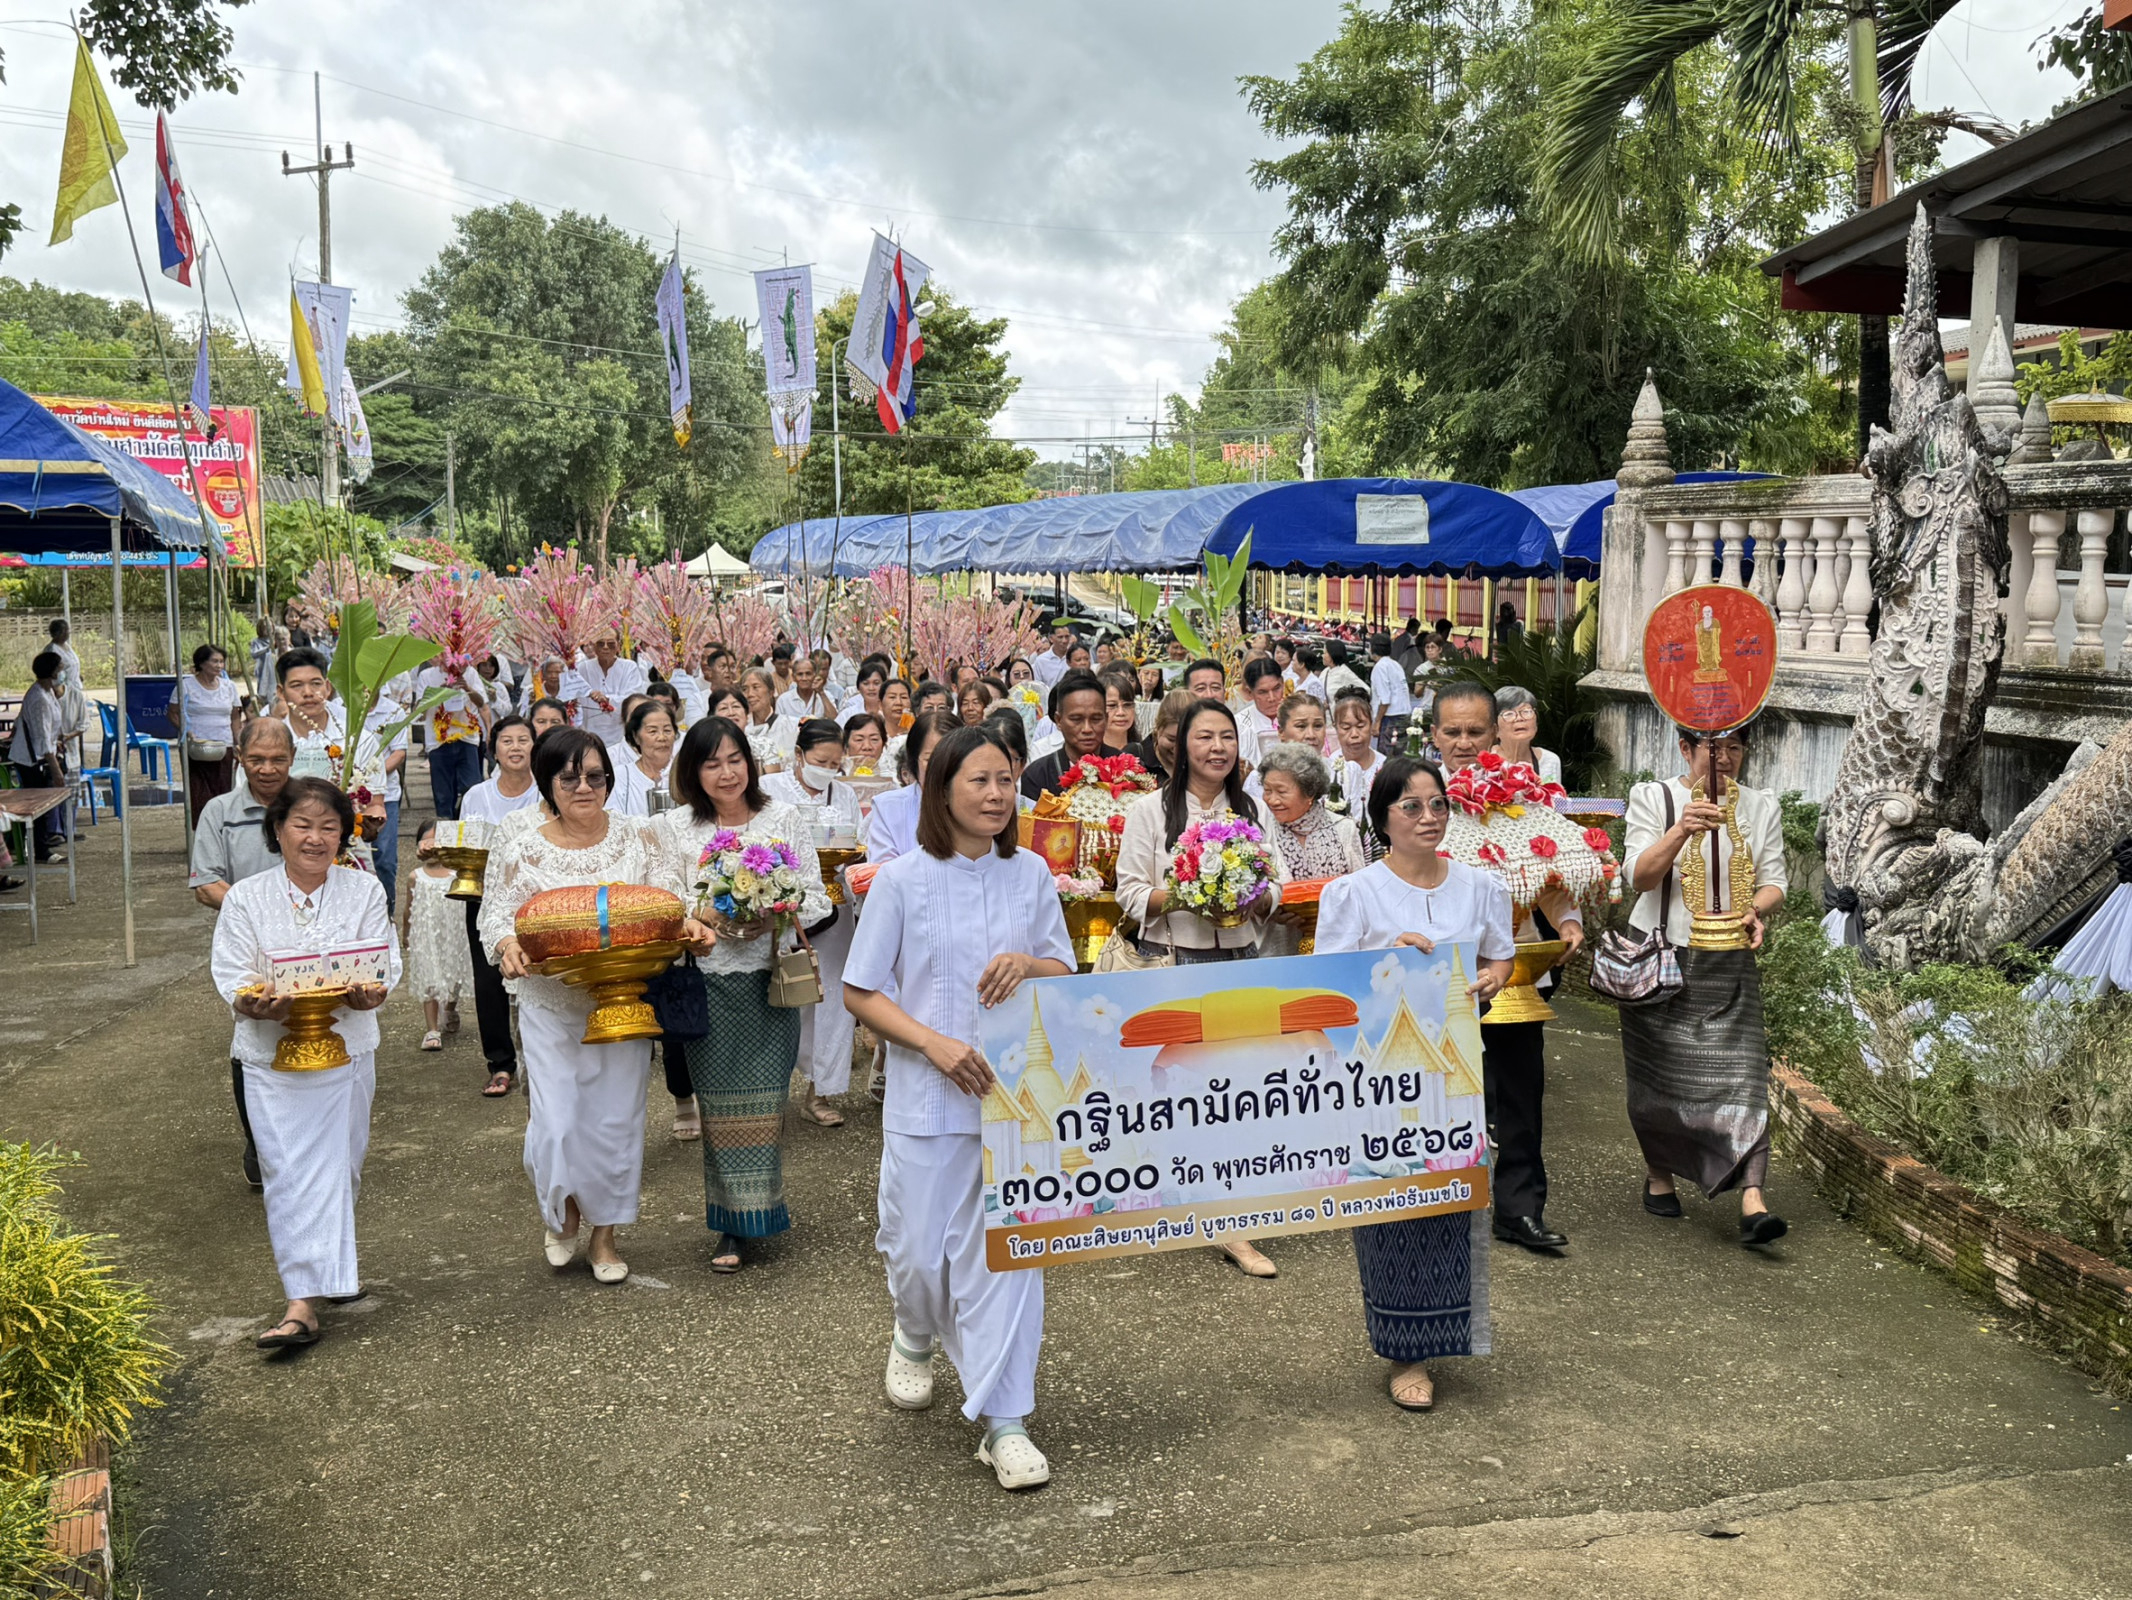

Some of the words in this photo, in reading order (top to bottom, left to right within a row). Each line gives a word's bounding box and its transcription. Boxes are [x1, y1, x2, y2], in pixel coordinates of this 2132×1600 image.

[133, 413, 192, 430] ยินดีต้อนับ
[1056, 1054, 1421, 1152] กฐินสามัคคีทั่วไทย
[1002, 1164, 1160, 1207] ๓๐,๐๐๐
[1172, 1156, 1204, 1185] วัด
[1213, 1144, 1350, 1190] พุทธศักราช
[1361, 1121, 1473, 1161] ๒๕๖๘
[1009, 1237, 1044, 1257] โดย
[1052, 1215, 1194, 1252] คณะศิษยานุศิษย์
[1202, 1210, 1284, 1238] บูชาธรรม
[1291, 1207, 1315, 1221] ๘๑
[1322, 1199, 1333, 1217] ปี
[1341, 1182, 1470, 1215] หลวงพ่อธัมมชโย
